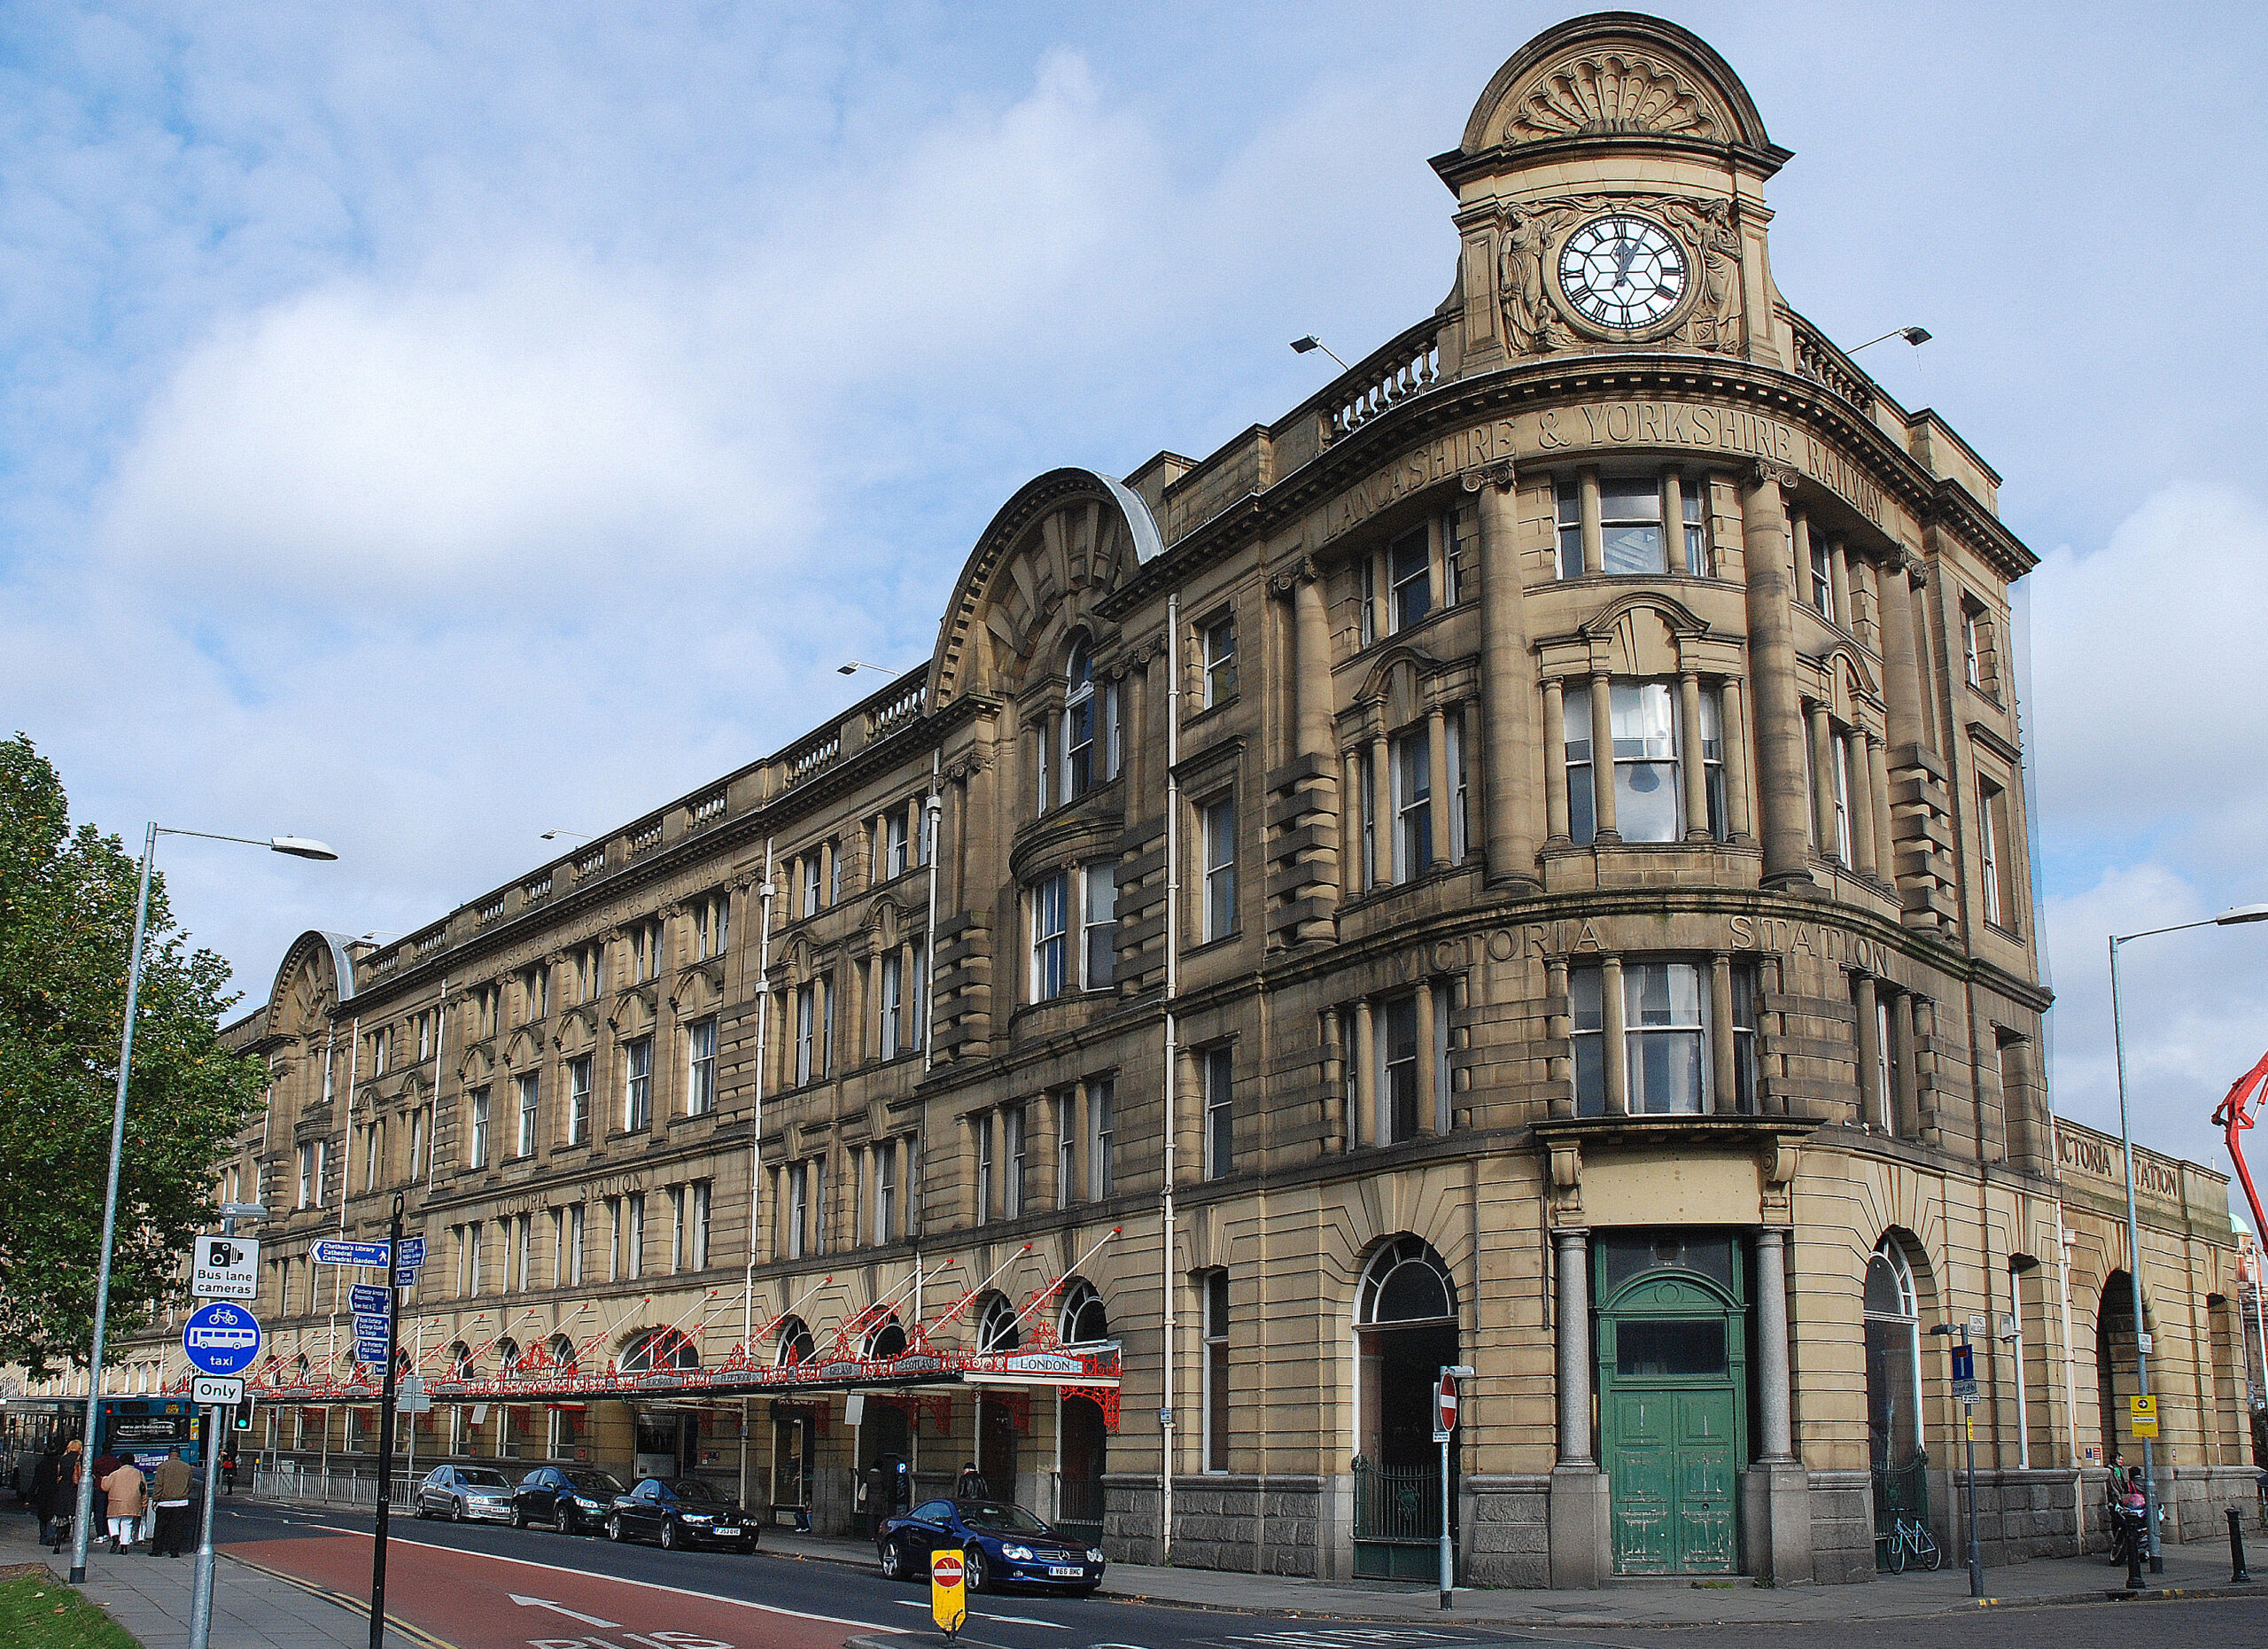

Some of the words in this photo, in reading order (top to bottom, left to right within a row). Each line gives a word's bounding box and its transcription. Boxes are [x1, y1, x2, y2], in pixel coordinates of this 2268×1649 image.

[1323, 420, 1517, 543] LANCASHIRE
[1539, 411, 1572, 449] &
[1581, 403, 1792, 464] YORKSHIRE
[1805, 435, 1884, 527] RAILWAY
[565, 892, 644, 945] YORKSHIRE
[655, 857, 723, 908] RAILWAY
[1394, 917, 1609, 974] VICTORIA
[1729, 915, 1888, 976] STATION
[2055, 1130, 2113, 1177] ICTORIA
[2132, 1154, 2177, 1197] TATION
[495, 1191, 550, 1216] VICTORIA
[580, 1172, 643, 1200] STATION
[322, 1242, 353, 1251] Chetham's
[198, 1269, 221, 1280] Bus
[226, 1271, 252, 1281] lane
[198, 1283, 251, 1294] cameras
[210, 1355, 234, 1366] taxi
[901, 1357, 934, 1372] SCOTLAND
[1021, 1358, 1070, 1371] LONDON
[200, 1383, 237, 1398] Only
